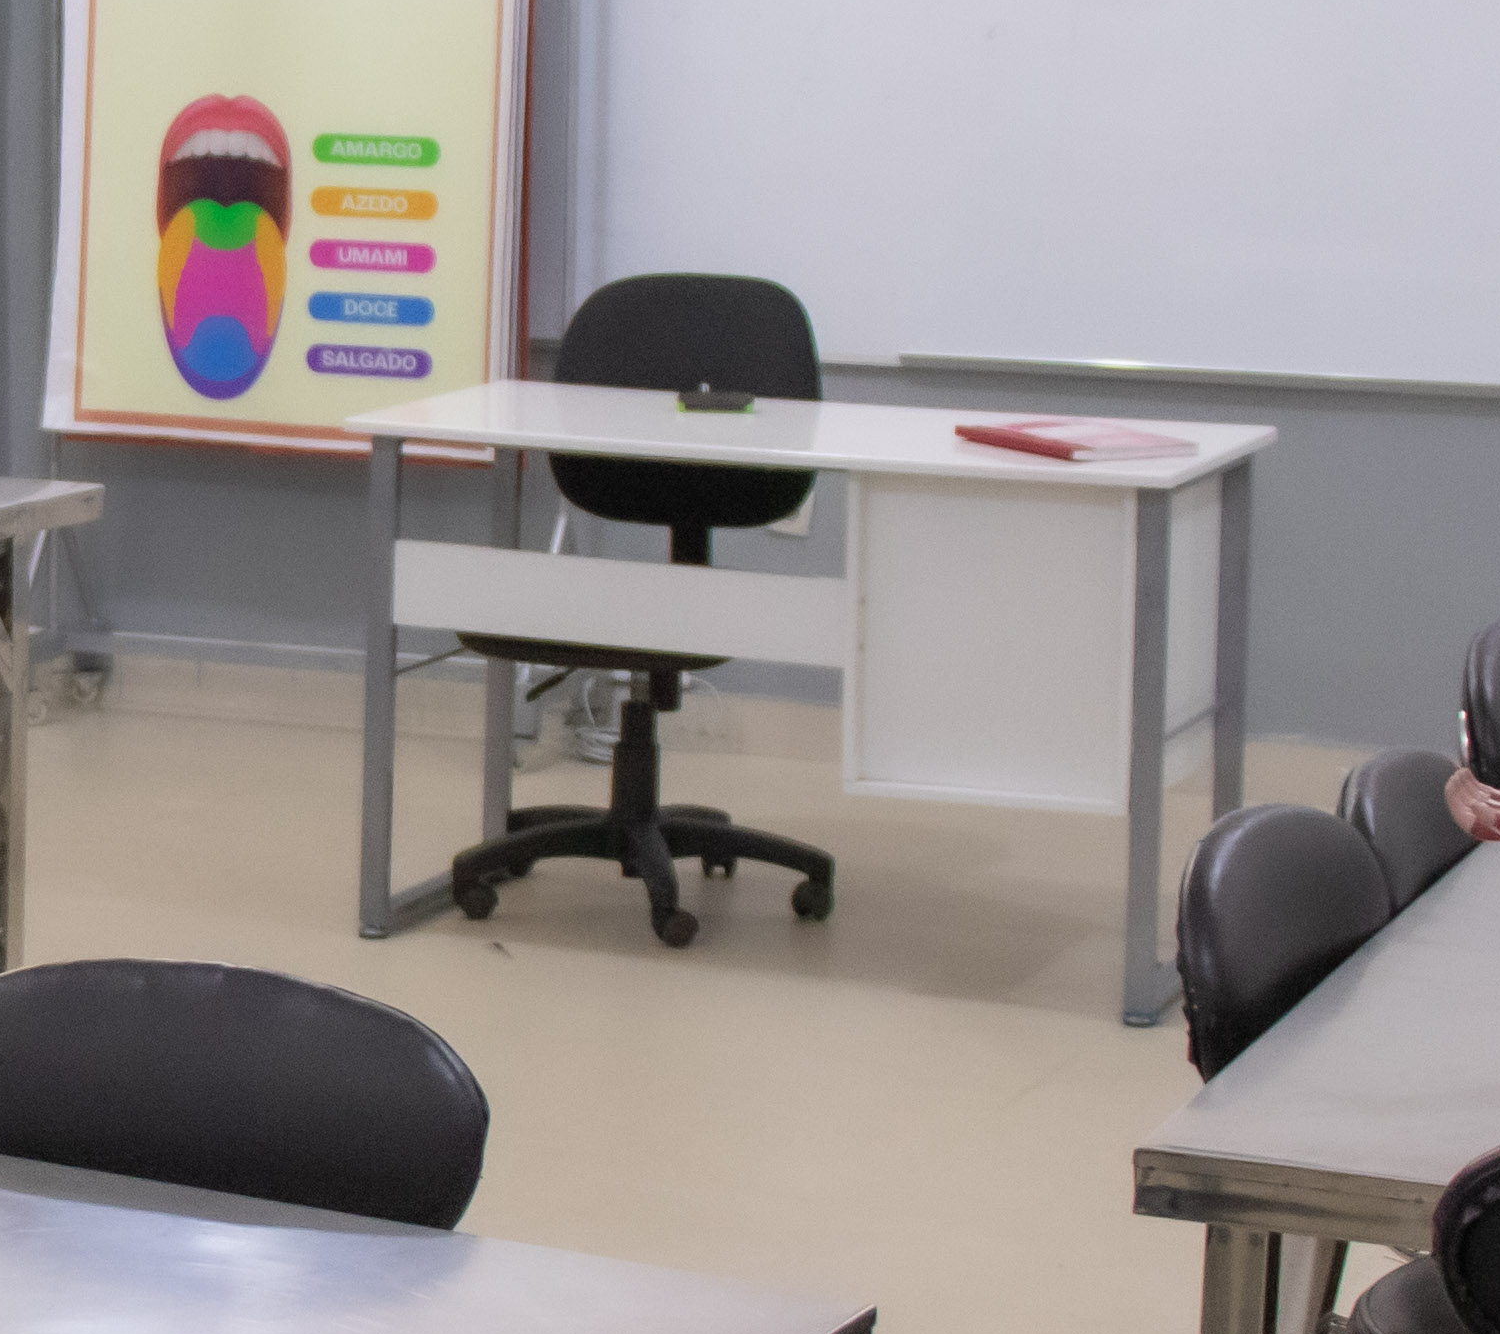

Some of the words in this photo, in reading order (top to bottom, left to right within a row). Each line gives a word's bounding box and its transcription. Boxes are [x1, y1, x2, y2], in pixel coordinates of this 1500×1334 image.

[331, 140, 422, 160] AMARGO
[341, 194, 409, 214] AZEDO
[337, 246, 408, 267] UMAMI
[344, 298, 398, 318] DOCE
[322, 350, 417, 371] SALGADO
